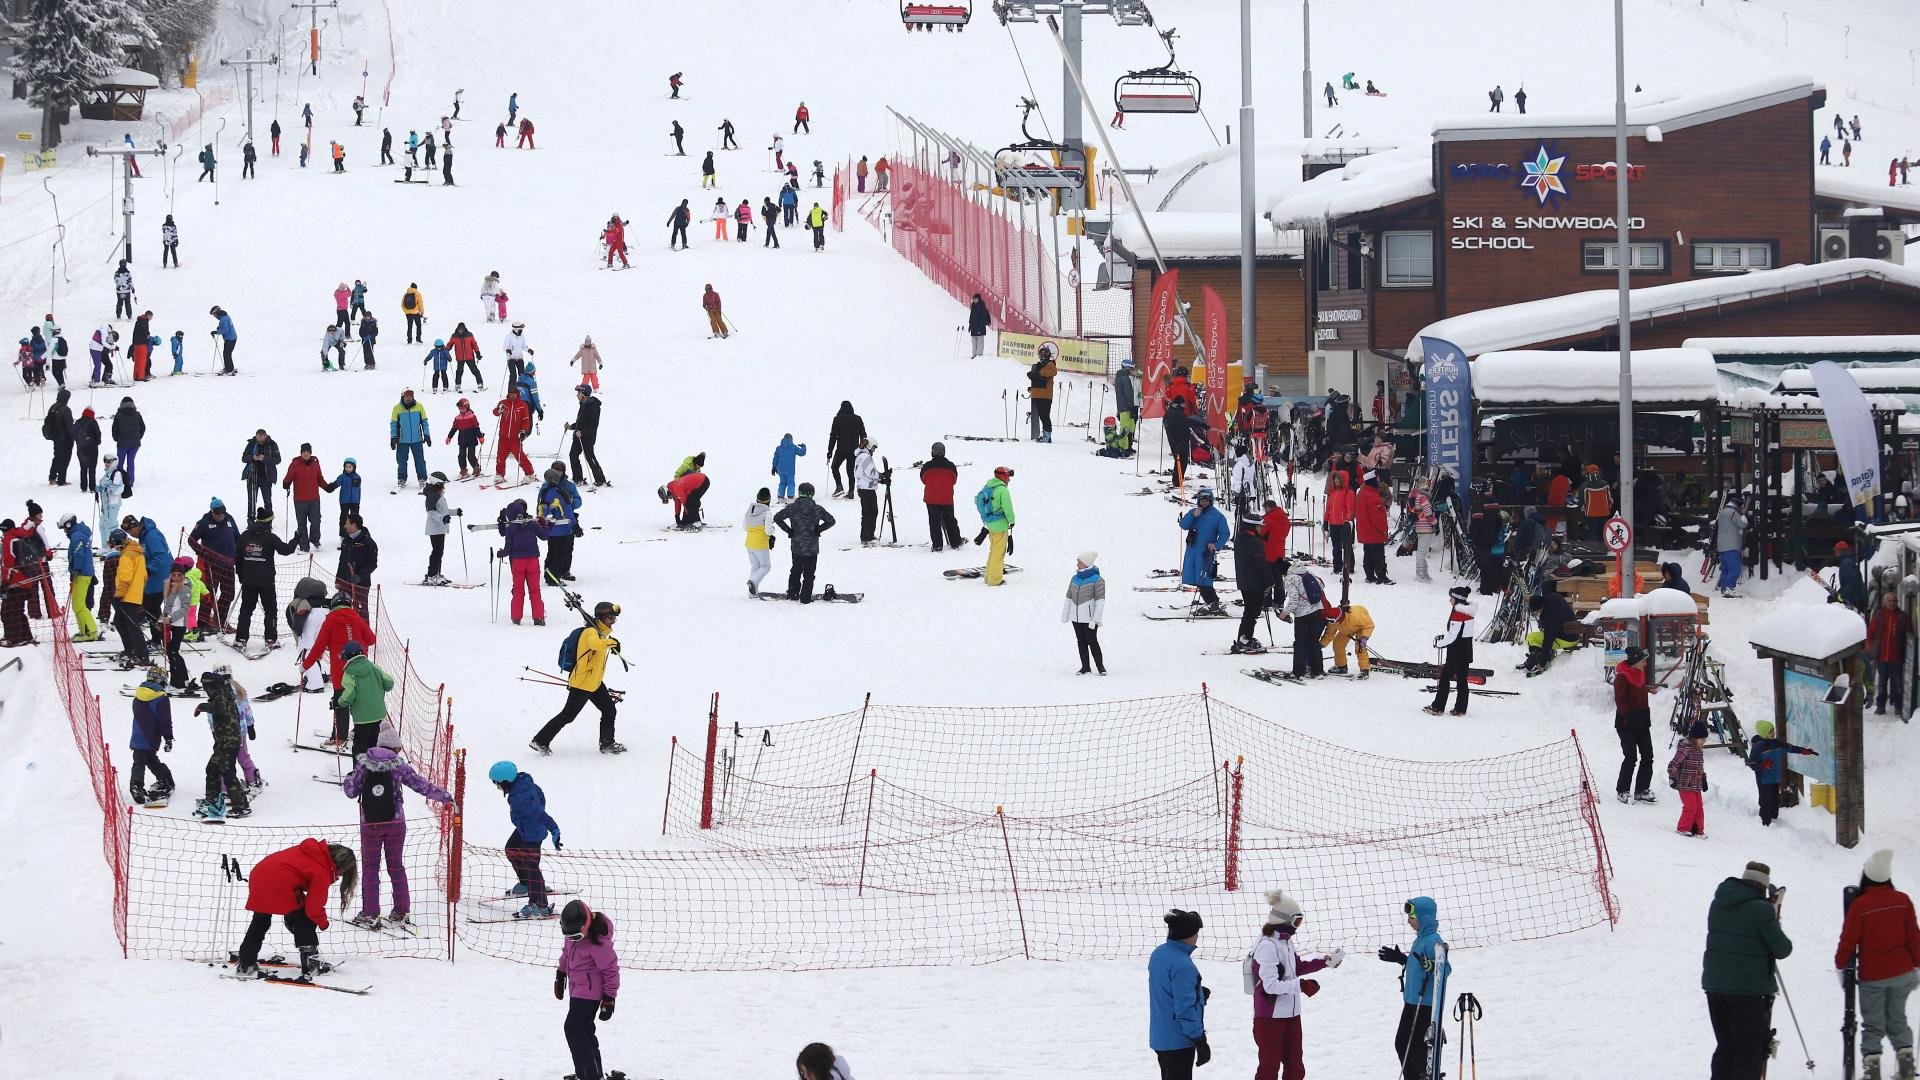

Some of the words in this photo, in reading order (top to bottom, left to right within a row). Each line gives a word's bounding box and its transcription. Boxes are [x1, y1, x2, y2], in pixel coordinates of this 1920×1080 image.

[1452, 216, 1483, 229] SKI
[1491, 216, 1507, 229] &
[1451, 236, 1535, 249] SCHOOL
[1533, 423, 1595, 442] BLACK
[1608, 420, 1659, 440] TER
